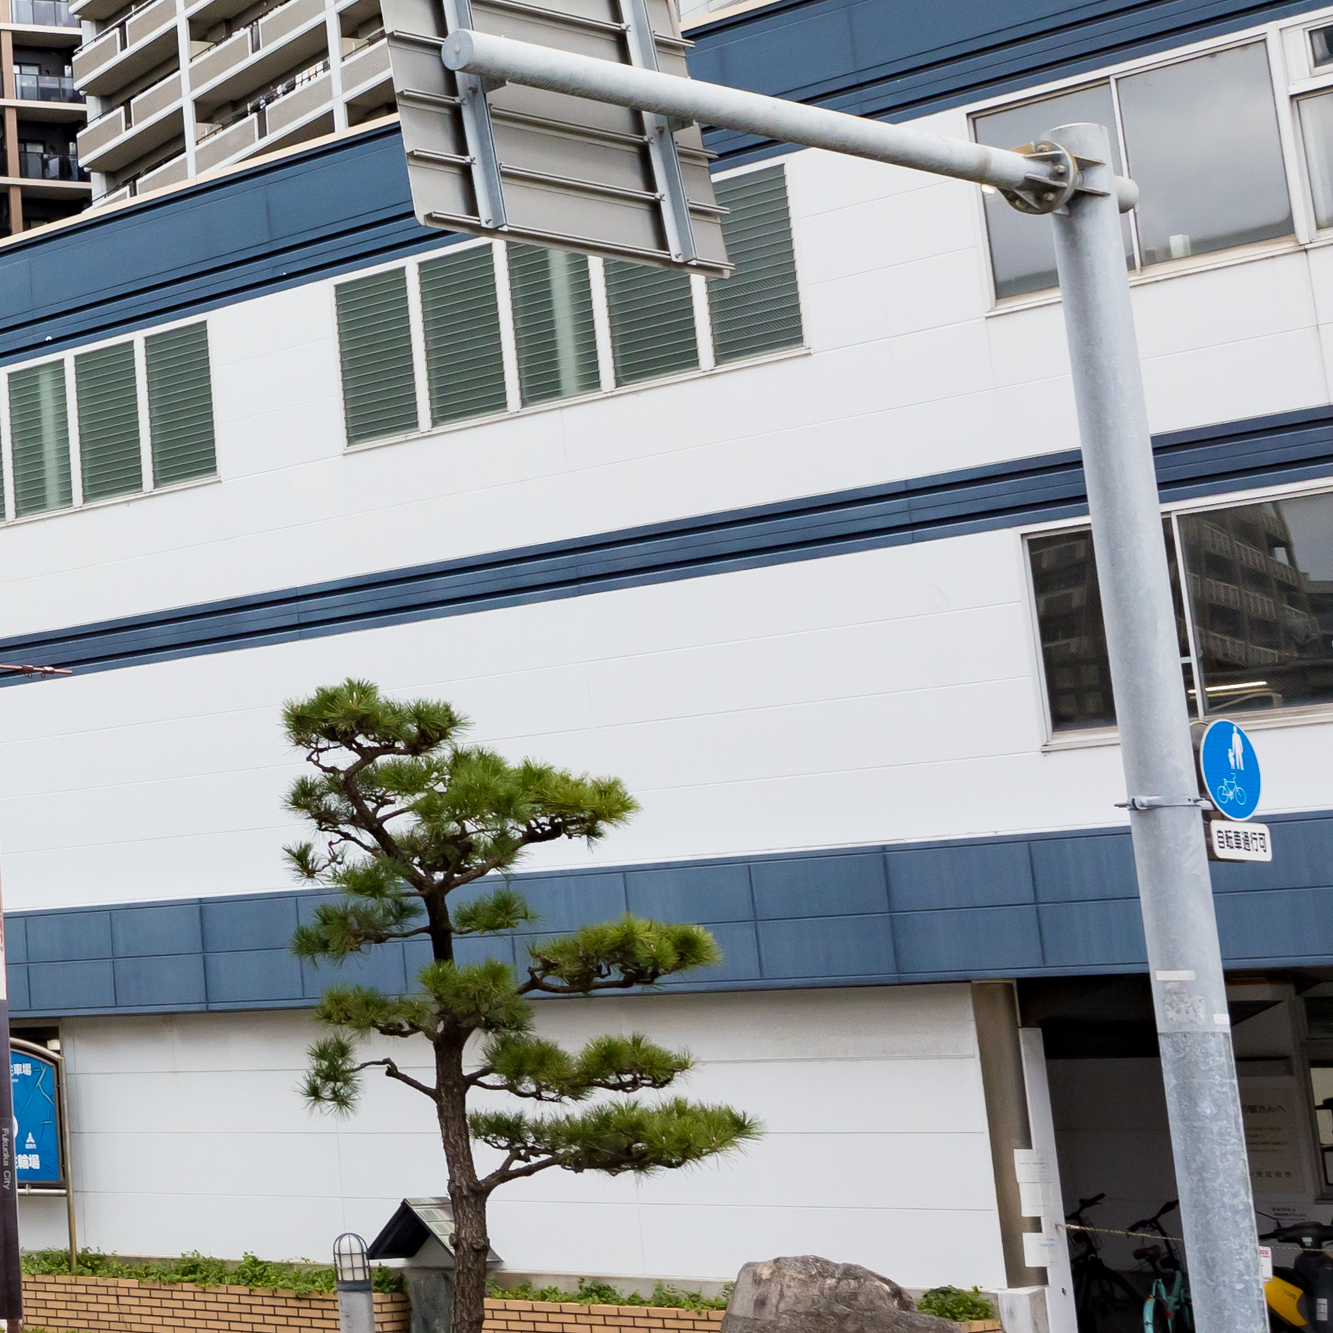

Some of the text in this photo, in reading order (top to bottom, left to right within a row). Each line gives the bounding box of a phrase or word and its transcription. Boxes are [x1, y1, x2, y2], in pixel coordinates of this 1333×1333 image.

[1217, 829, 1267, 853] 自転車通行可
[2, 1128, 11, 1191] Fukuoka City
